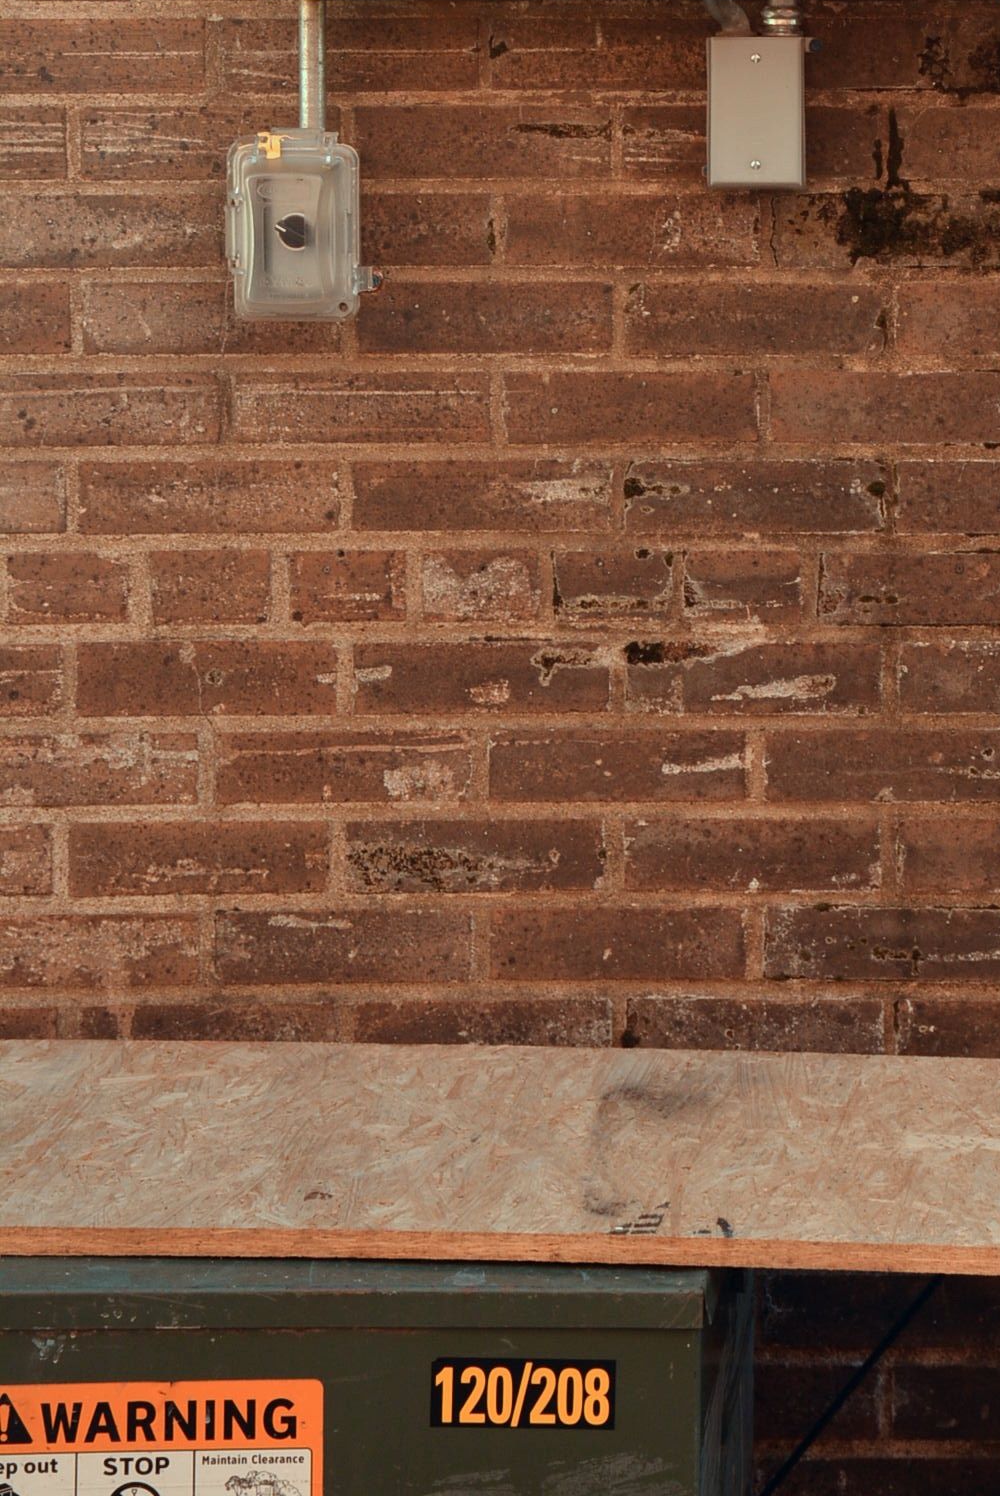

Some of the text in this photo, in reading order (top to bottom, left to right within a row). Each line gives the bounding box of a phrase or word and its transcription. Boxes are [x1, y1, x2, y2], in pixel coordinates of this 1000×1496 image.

[435, 1362, 610, 1427] 120/208
[40, 1398, 298, 1444] WARNING
[24, 1458, 58, 1474] out
[103, 1457, 170, 1476] STOP
[202, 1454, 305, 1465] Maintain Clearance
